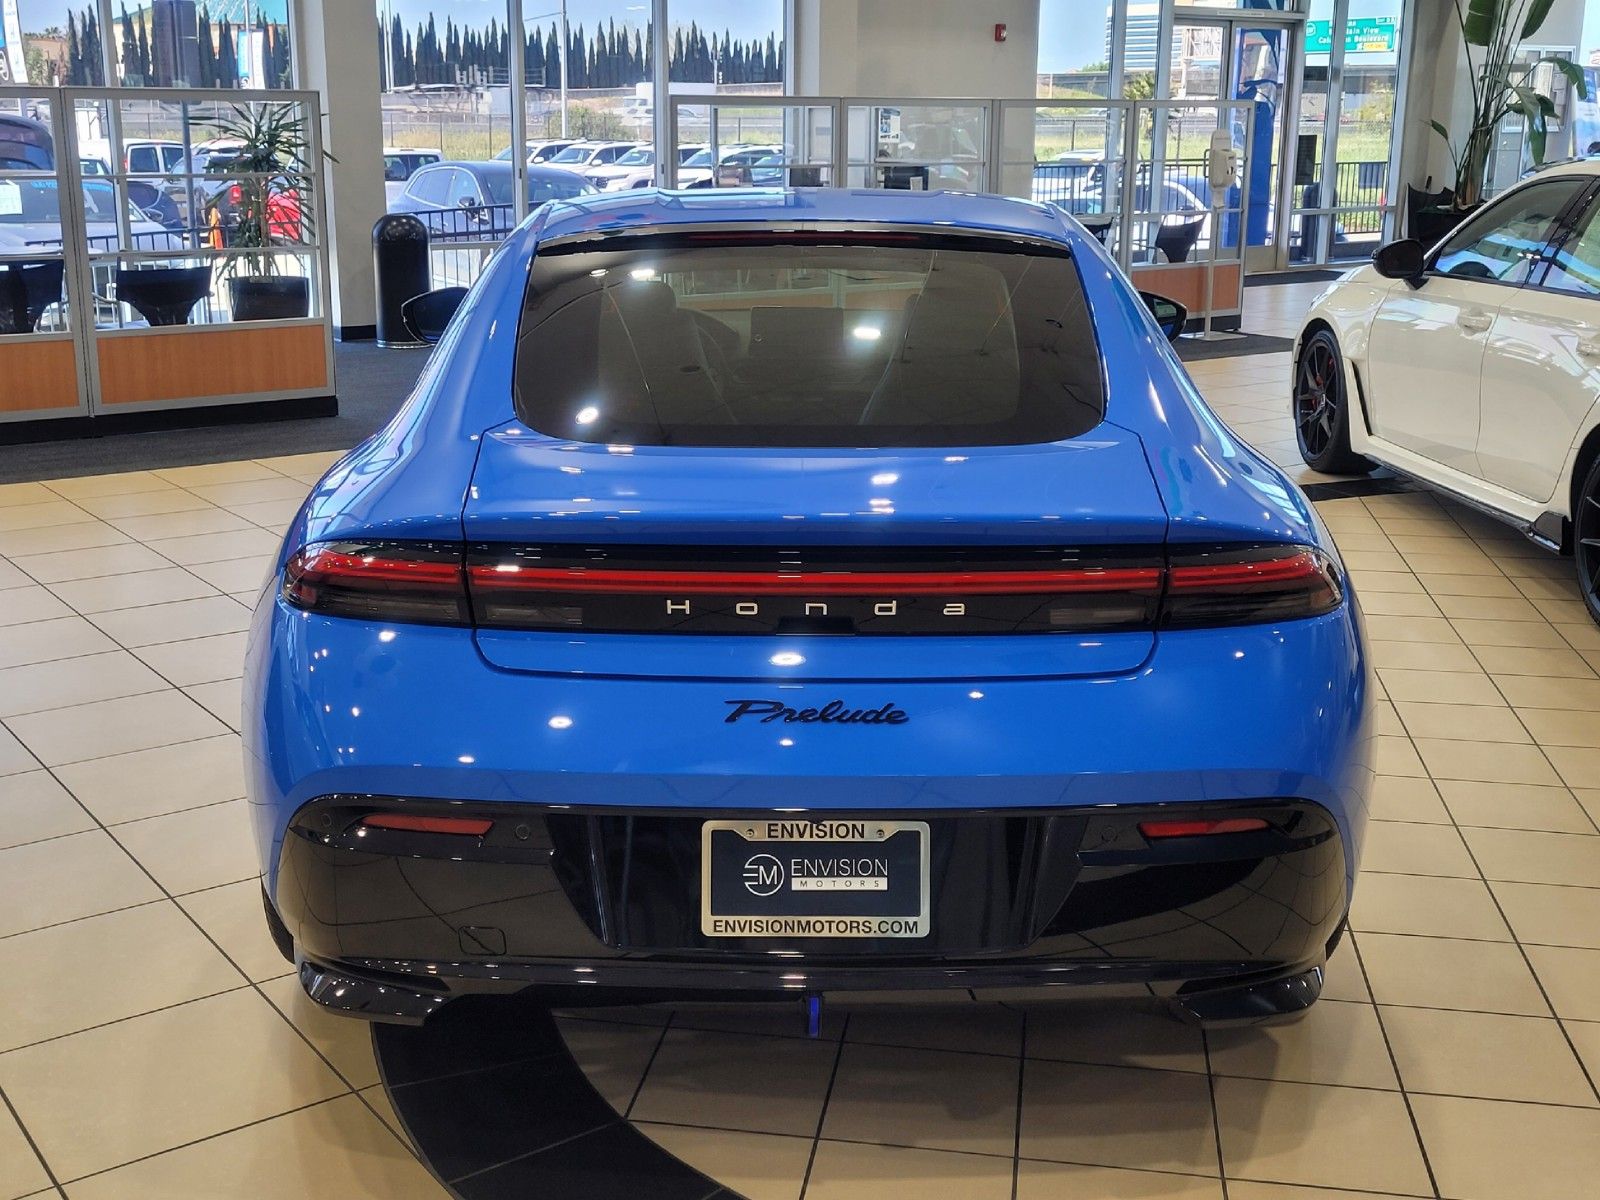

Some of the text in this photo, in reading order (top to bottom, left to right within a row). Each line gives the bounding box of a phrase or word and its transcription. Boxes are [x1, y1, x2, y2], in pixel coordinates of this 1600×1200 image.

[724, 699, 910, 725] Prelude
[767, 823, 865, 839] ENVISION
[791, 858, 888, 876] ENVISION
[799, 880, 880, 888] MOTORS
[713, 919, 918, 934] ENVISIONMOTORS.COM
